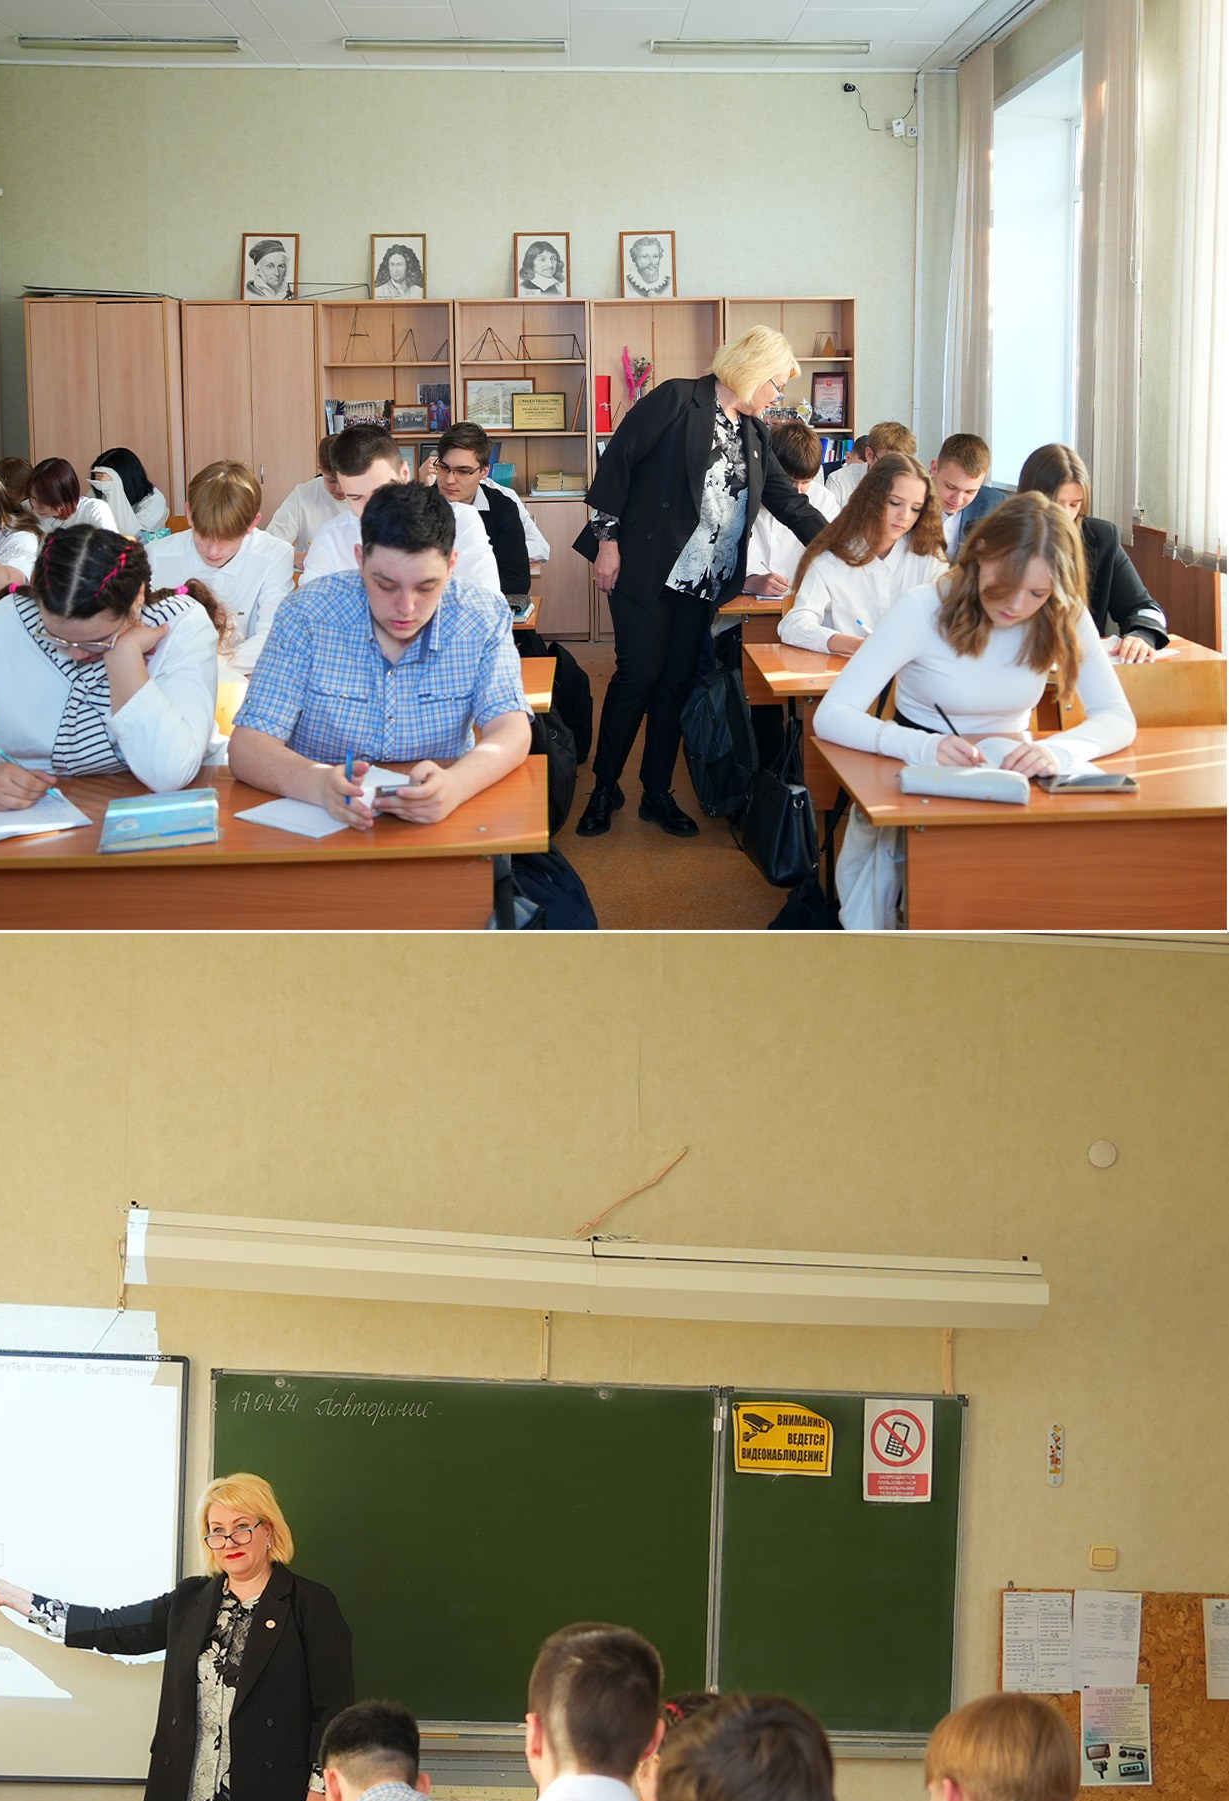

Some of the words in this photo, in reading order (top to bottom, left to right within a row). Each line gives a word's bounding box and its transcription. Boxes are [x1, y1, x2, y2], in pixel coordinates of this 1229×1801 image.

[777, 1413, 825, 1429] ВНИМАНИЕ!
[787, 1432, 825, 1446] ВЕДЕТСЯ
[741, 1447, 824, 1463] ВИДЕОНАБЛЮДЕНИЕ
